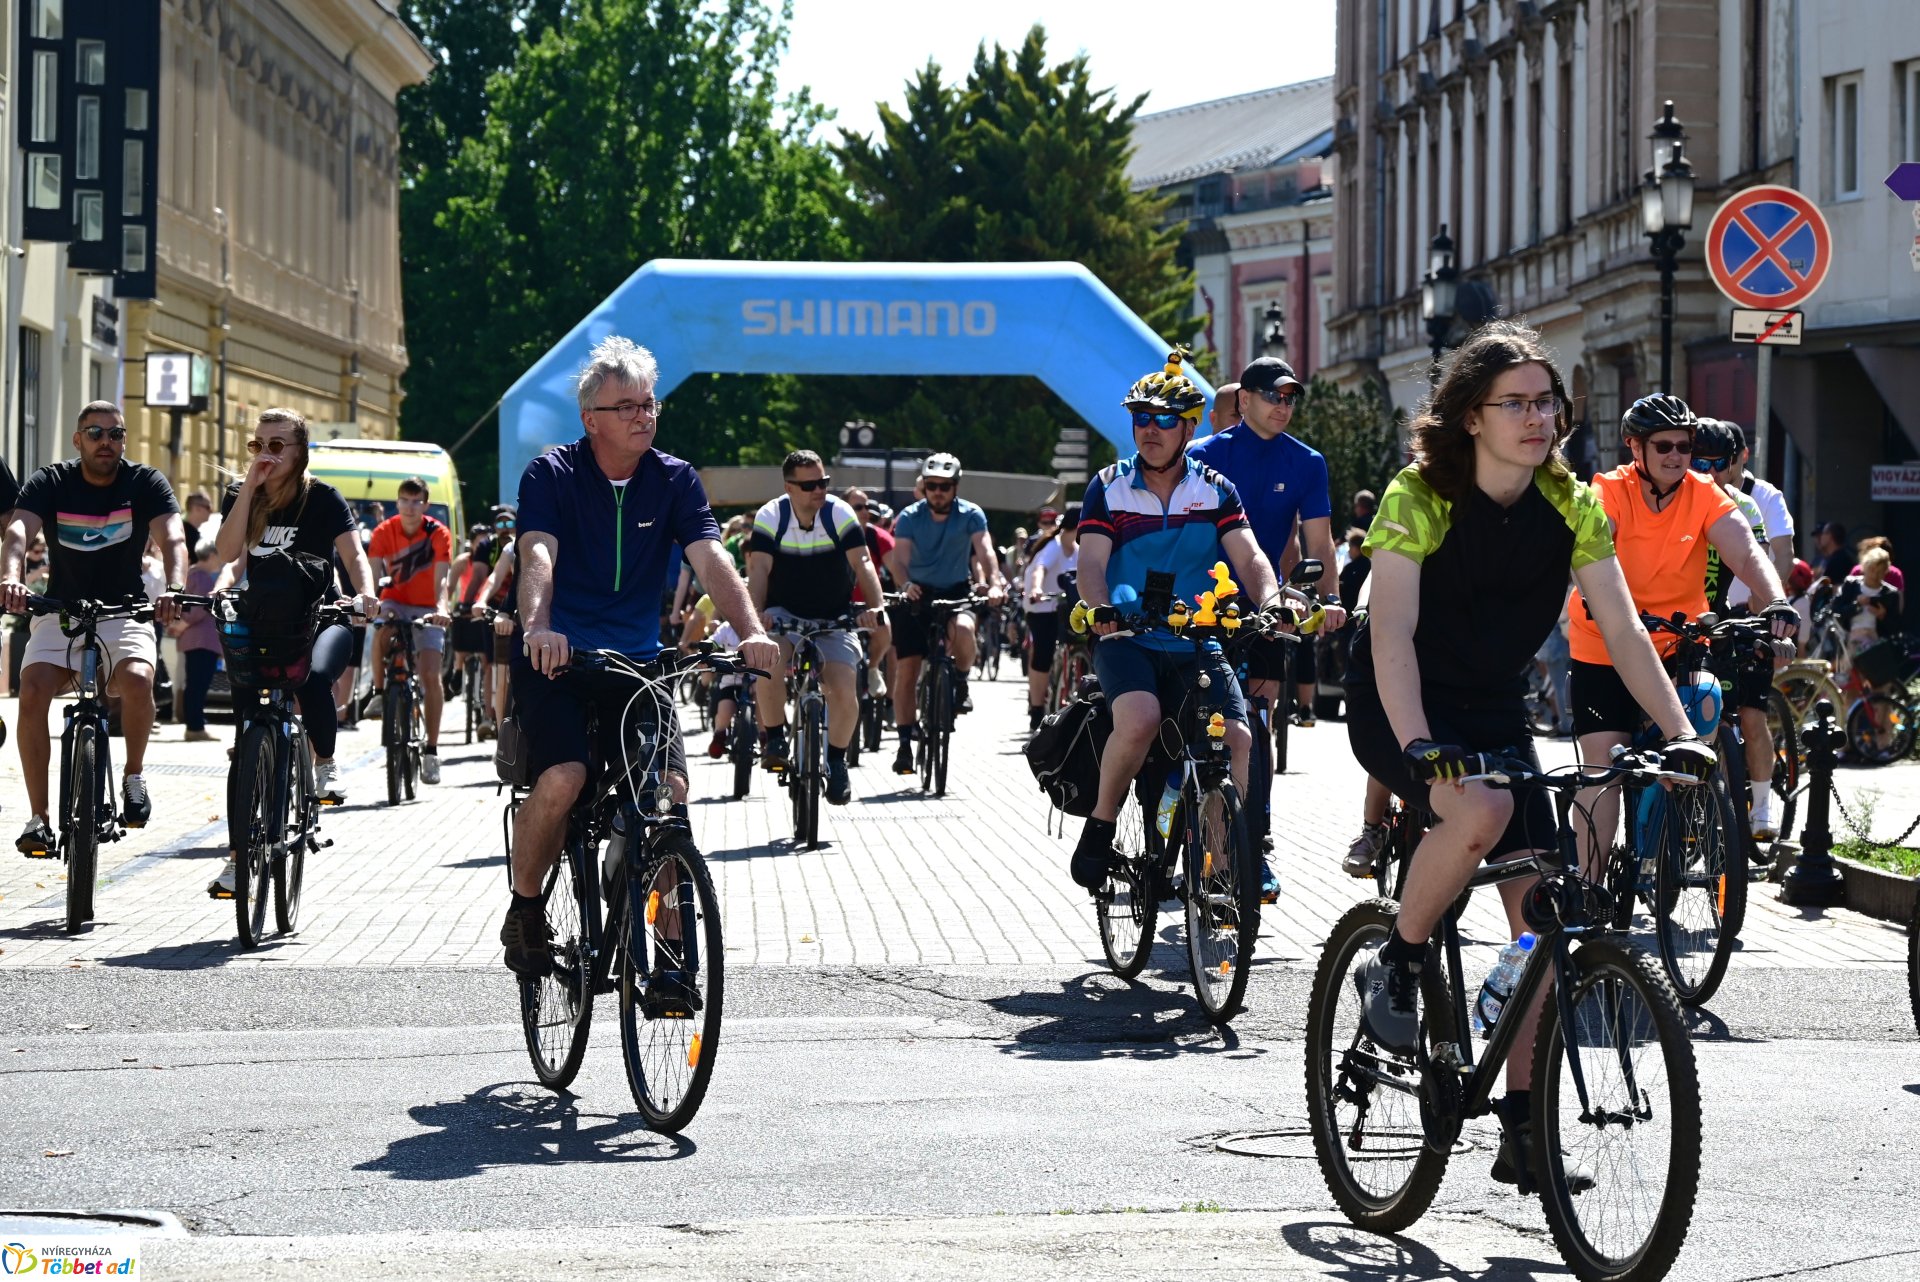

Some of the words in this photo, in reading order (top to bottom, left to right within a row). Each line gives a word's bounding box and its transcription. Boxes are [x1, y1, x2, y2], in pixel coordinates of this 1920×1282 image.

[742, 299, 997, 337] SHIMANO
[1871, 468, 1920, 482] VIGYÁZ
[261, 525, 299, 545] NIKE
